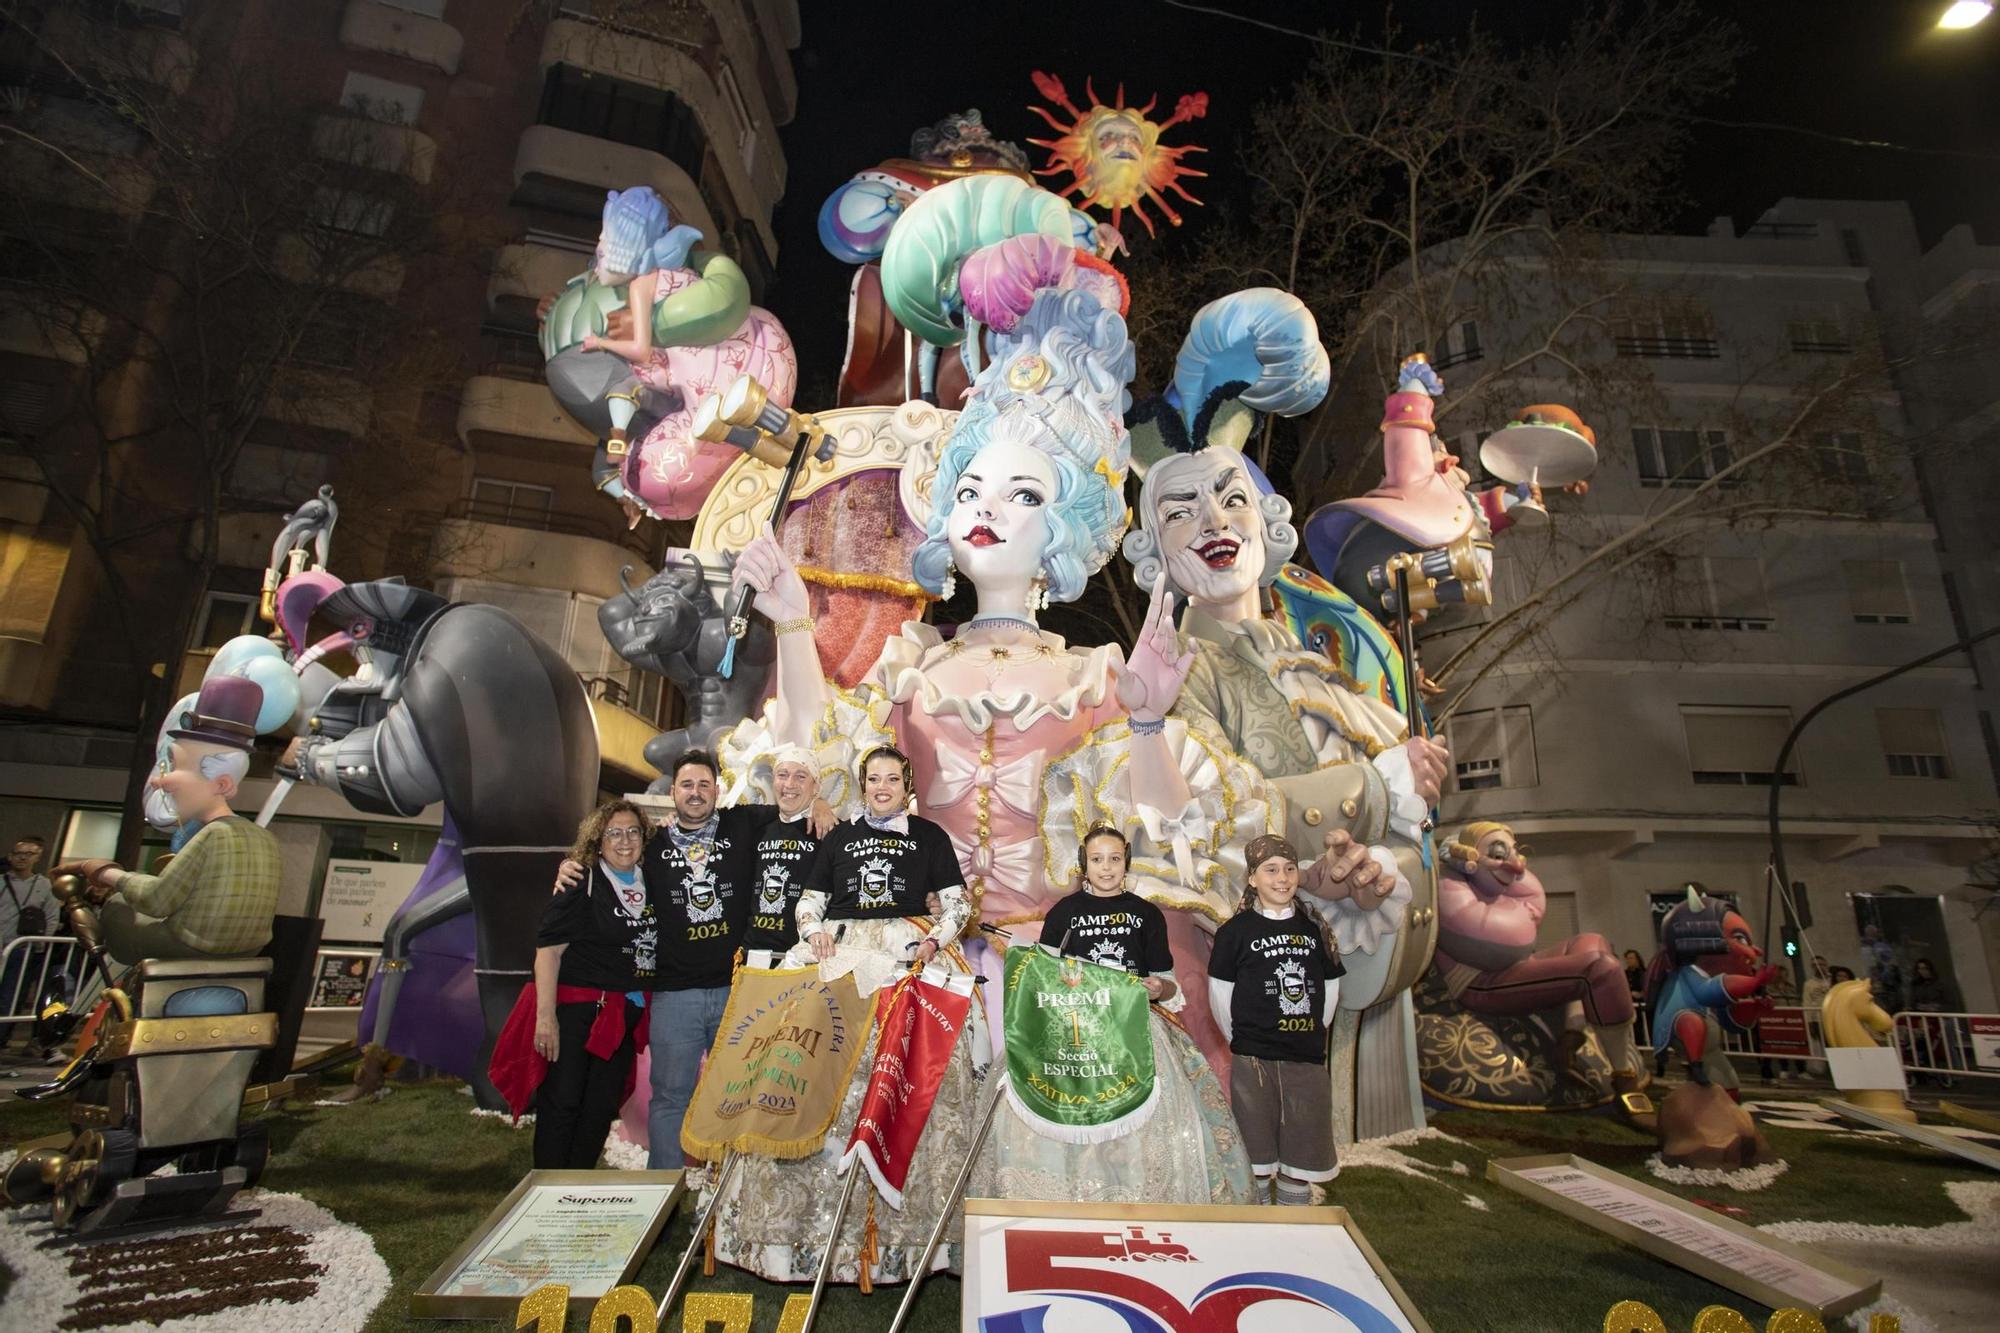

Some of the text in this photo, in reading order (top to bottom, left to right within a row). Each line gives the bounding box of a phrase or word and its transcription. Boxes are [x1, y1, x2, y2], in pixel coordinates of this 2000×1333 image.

[687, 920, 730, 941] 2024
[1071, 912, 1143, 929] CAMP50NS
[1250, 934, 1317, 952] CAMP50NS
[1036, 987, 1112, 1008] PREMI
[819, 986, 845, 1054] FALLERA
[1064, 1009, 1088, 1048] 1
[1278, 1018, 1315, 1032] 2024
[1043, 1062, 1118, 1078] ESPECIAL
[1095, 1074, 1137, 1103] 2024
